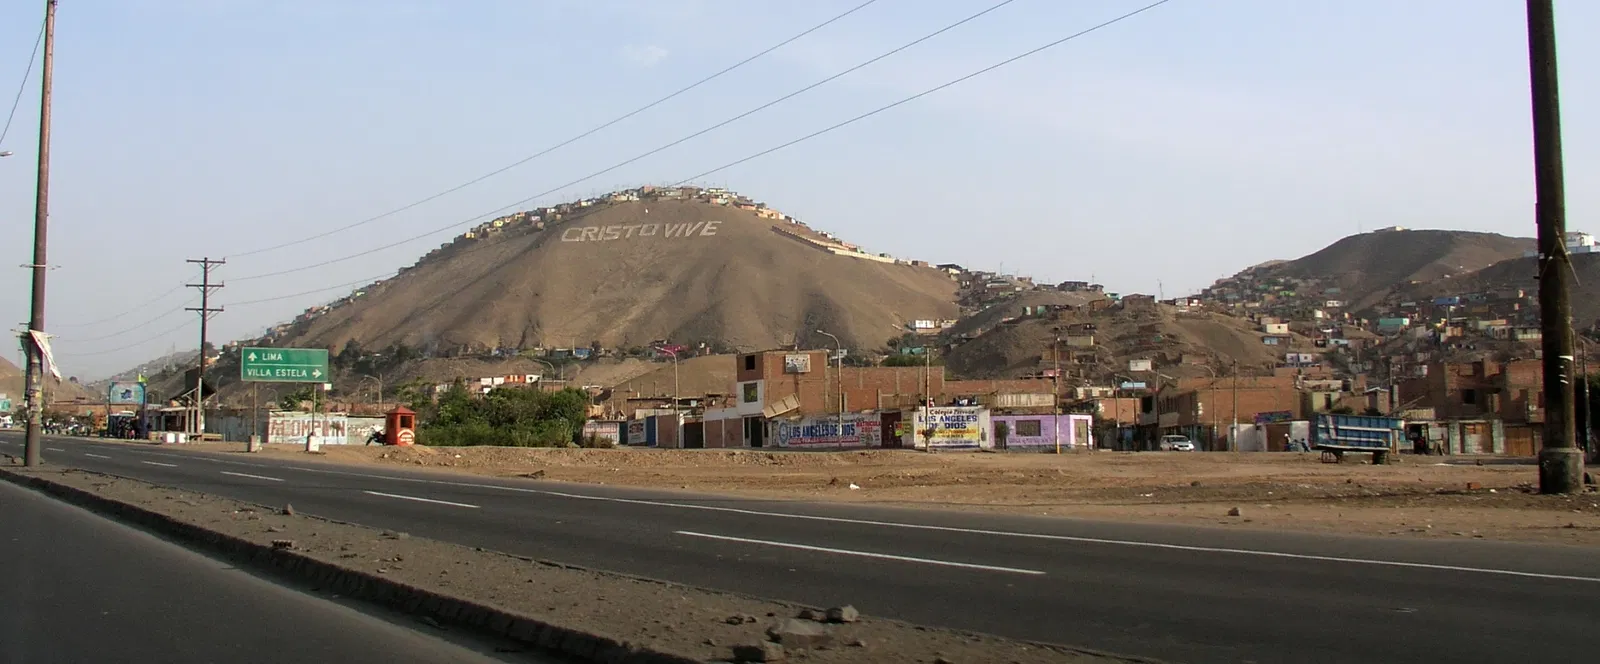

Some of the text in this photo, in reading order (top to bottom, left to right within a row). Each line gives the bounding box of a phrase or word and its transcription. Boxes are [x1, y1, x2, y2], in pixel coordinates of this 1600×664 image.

[561, 220, 722, 242] CRISTO VIVE
[262, 352, 283, 361] LIMA
[247, 368, 307, 377] VILLA ESTELA
[789, 426, 801, 438] LOS
[802, 424, 829, 437] ANGELES
[830, 424, 838, 436] DE
